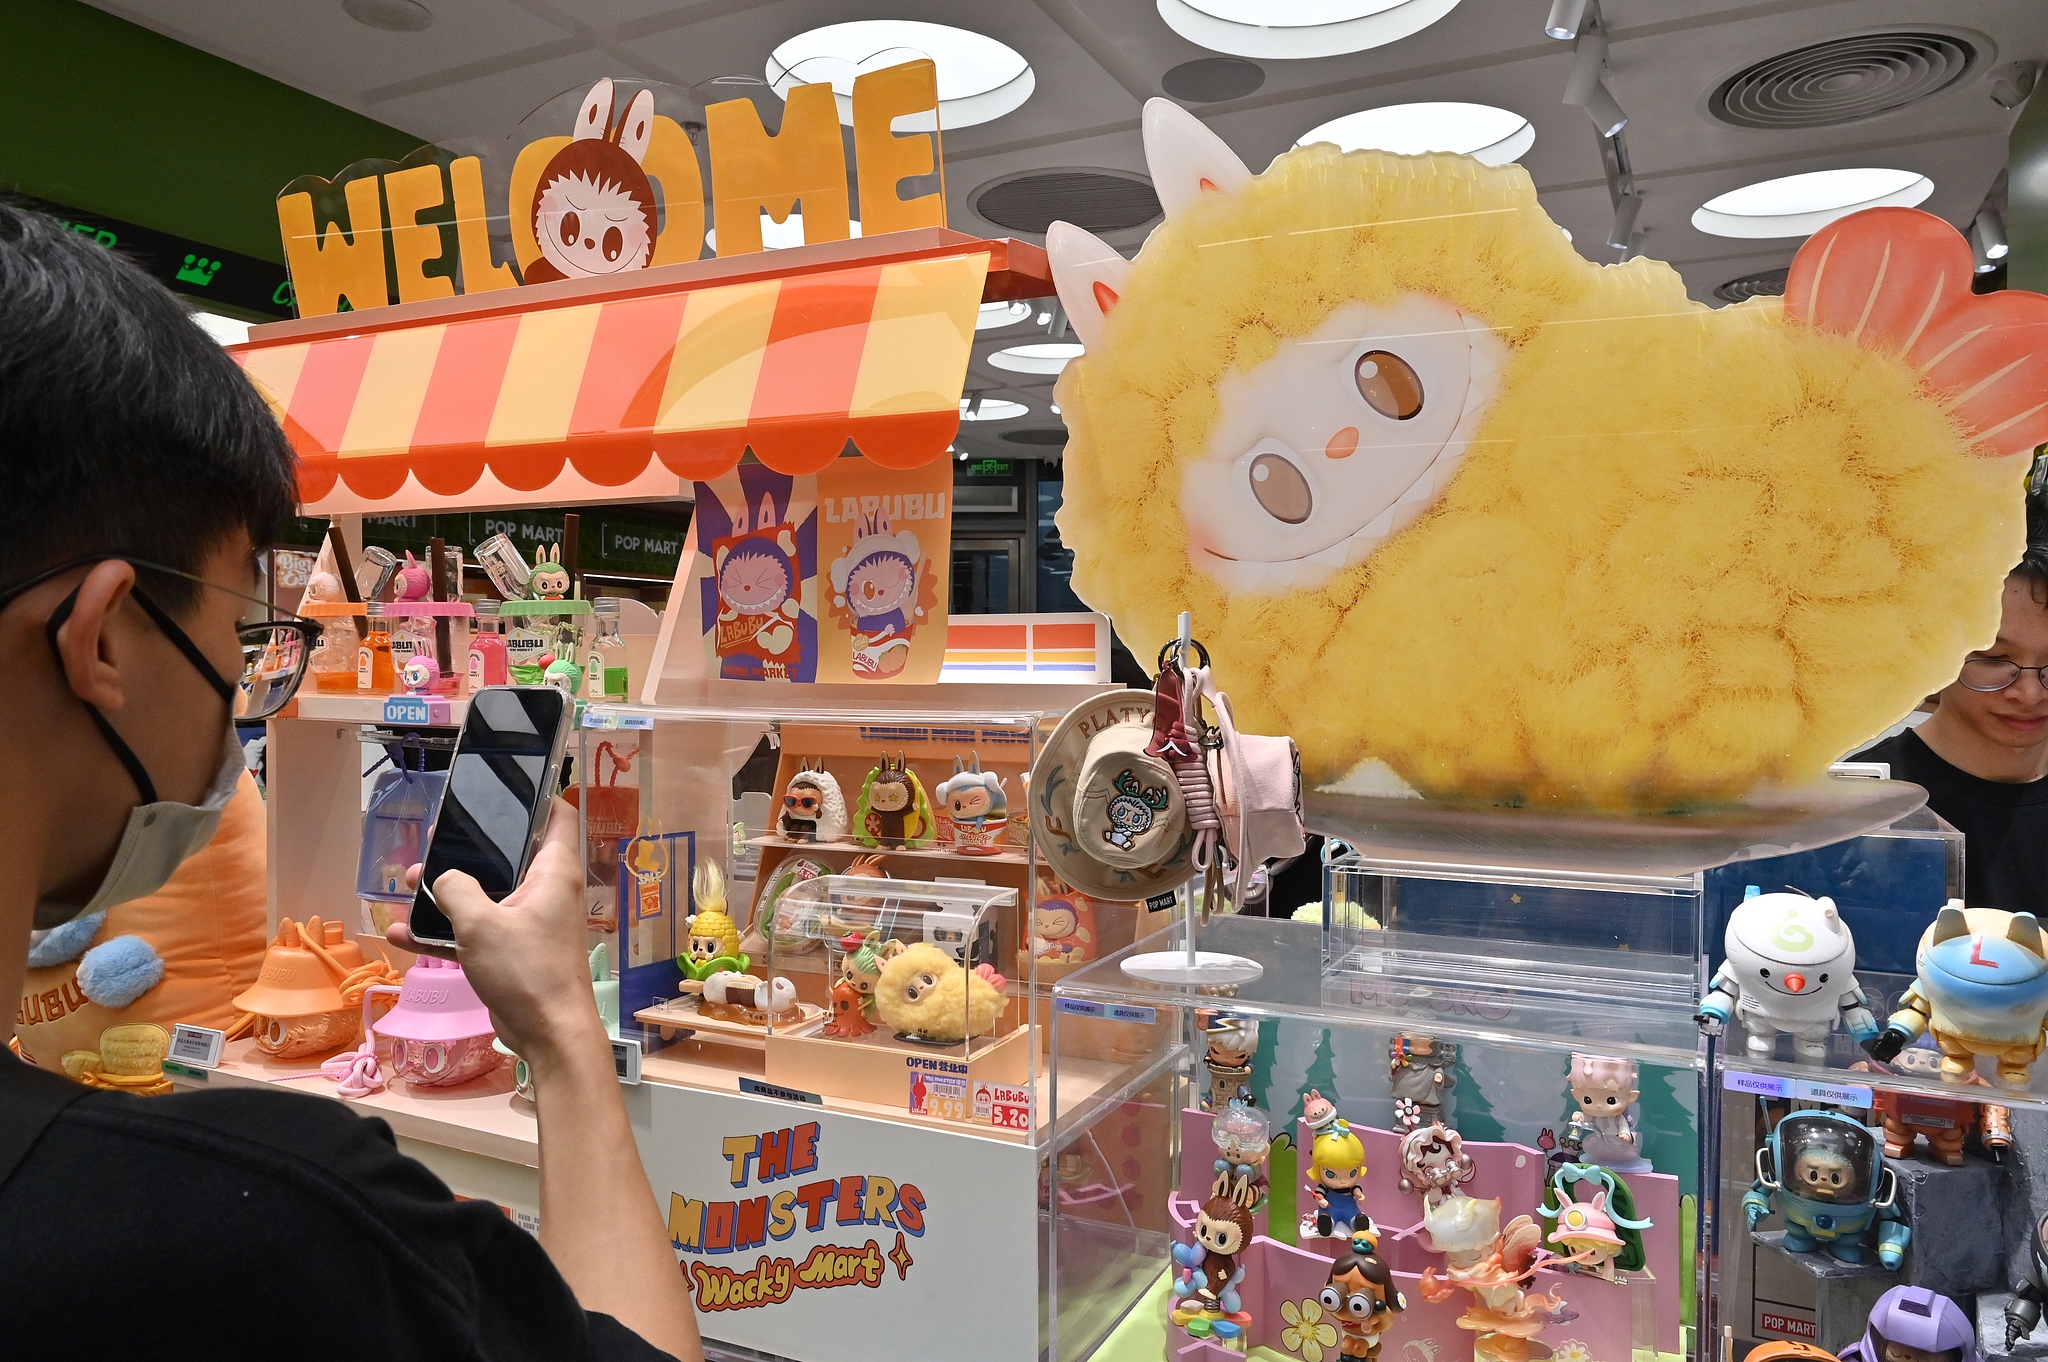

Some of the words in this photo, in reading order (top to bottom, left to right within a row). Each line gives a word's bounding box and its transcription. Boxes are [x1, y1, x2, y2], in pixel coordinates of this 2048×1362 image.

[824, 492, 946, 523] LABUBU
[485, 518, 517, 537] POP
[521, 523, 564, 543] MART
[615, 534, 640, 550] POP
[644, 539, 678, 555] MART
[720, 615, 764, 643] LABUBU
[507, 639, 543, 648] ABUBU
[852, 651, 878, 670] LABUBU
[751, 667, 798, 679] MARKET
[386, 705, 426, 721] OPEN
[1077, 706, 1156, 739] PLATY
[1148, 899, 1159, 910] POP
[1159, 896, 1175, 907] MART
[1970, 936, 1999, 968] L
[16, 978, 88, 1027] UBU
[404, 986, 449, 1005] LABUBU
[906, 1056, 938, 1071] OPEN
[994, 1087, 1030, 1104] LABUBU
[1737, 1078, 1783, 1093] 样品仅供展示
[1810, 1087, 1859, 1102] 道具仅供展示
[929, 1098, 964, 1119] 9.99
[993, 1106, 1030, 1128] 5.20
[722, 1121, 821, 1189] THE
[667, 1175, 927, 1254] MONSTERS
[695, 1260, 791, 1307] Wacky
[798, 1246, 881, 1284] Mart
[1763, 1316, 1785, 1330] POP
[1786, 1319, 1816, 1337] MART
